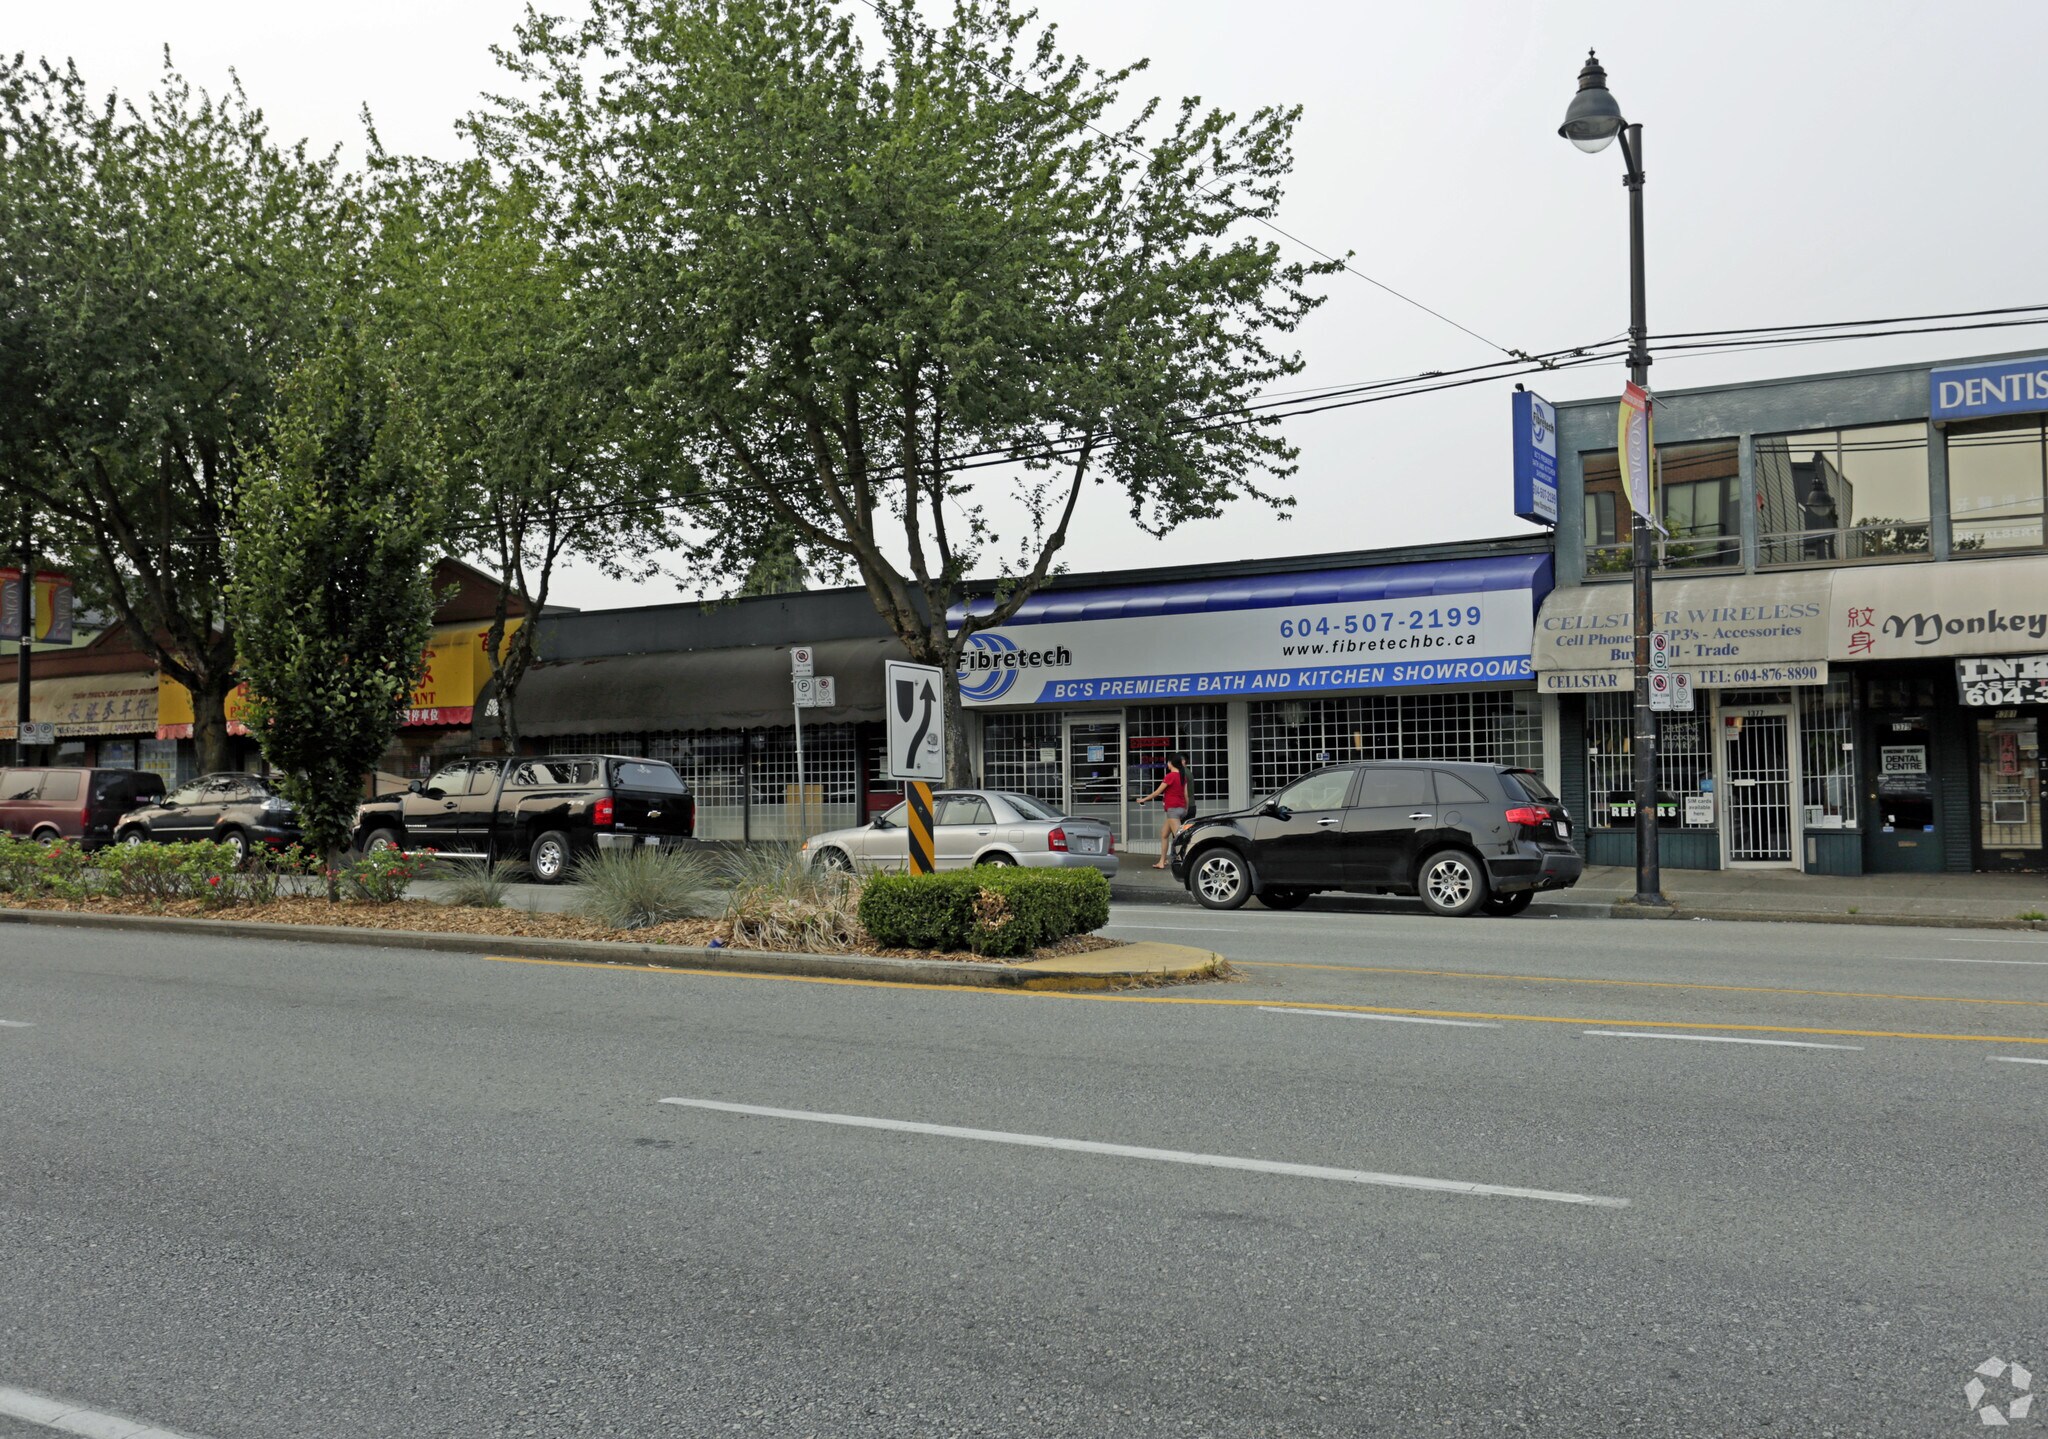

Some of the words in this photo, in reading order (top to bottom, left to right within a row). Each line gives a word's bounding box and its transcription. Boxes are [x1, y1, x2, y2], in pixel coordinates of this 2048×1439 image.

[1631, 415, 1643, 491] SAIGON
[1280, 606, 1481, 639] 604-507-2199
[1688, 602, 1821, 624] WIRELESS
[1556, 634, 1584, 647] Cell
[1713, 624, 1802, 640] Accessories
[1882, 609, 2048, 645] Monkey
[1282, 634, 1477, 656] www.fibretechbc.ca
[1694, 643, 1740, 657] Trade
[957, 645, 1072, 670] Fibretech
[1055, 682, 1093, 698] BC'S
[1100, 678, 1191, 696] PREMIERE
[1197, 671, 1246, 692] BATH
[1252, 672, 1291, 689] AND
[1298, 667, 1385, 687] KITCHEN
[1392, 659, 1531, 681] SHOWROOMS
[1548, 674, 1618, 689] CELLSTAR
[1699, 670, 1731, 684] TEL:
[1734, 666, 1817, 683] 604-876-8890
[1963, 679, 2032, 691] LASER
[1885, 762, 1923, 771] CENTRE
[1886, 755, 1922, 763] DENTAL
[1612, 806, 1676, 817] REPRS
